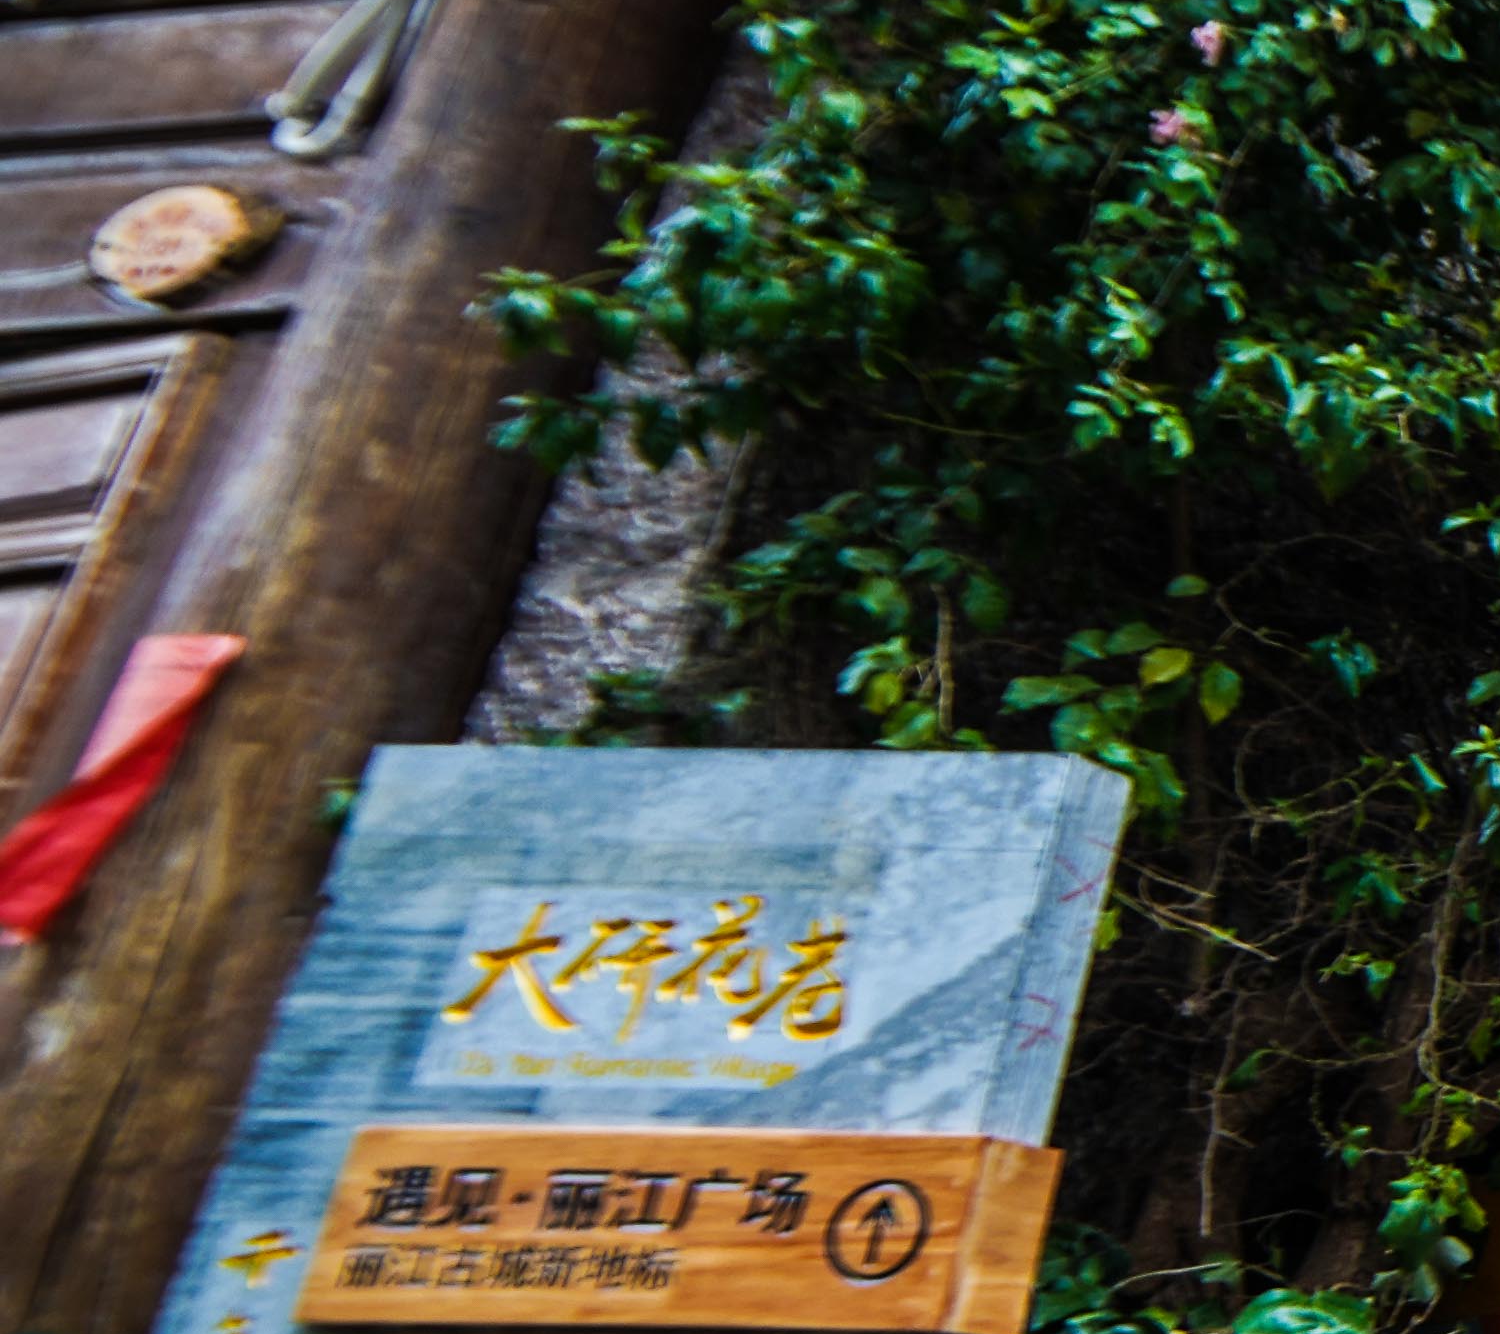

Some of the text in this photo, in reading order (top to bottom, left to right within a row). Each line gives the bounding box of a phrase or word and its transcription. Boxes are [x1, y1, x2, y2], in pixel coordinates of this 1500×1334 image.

[356, 1165, 811, 1235] 遇见·丽江广场
[335, 1242, 681, 1290] 丽江古城新地标
